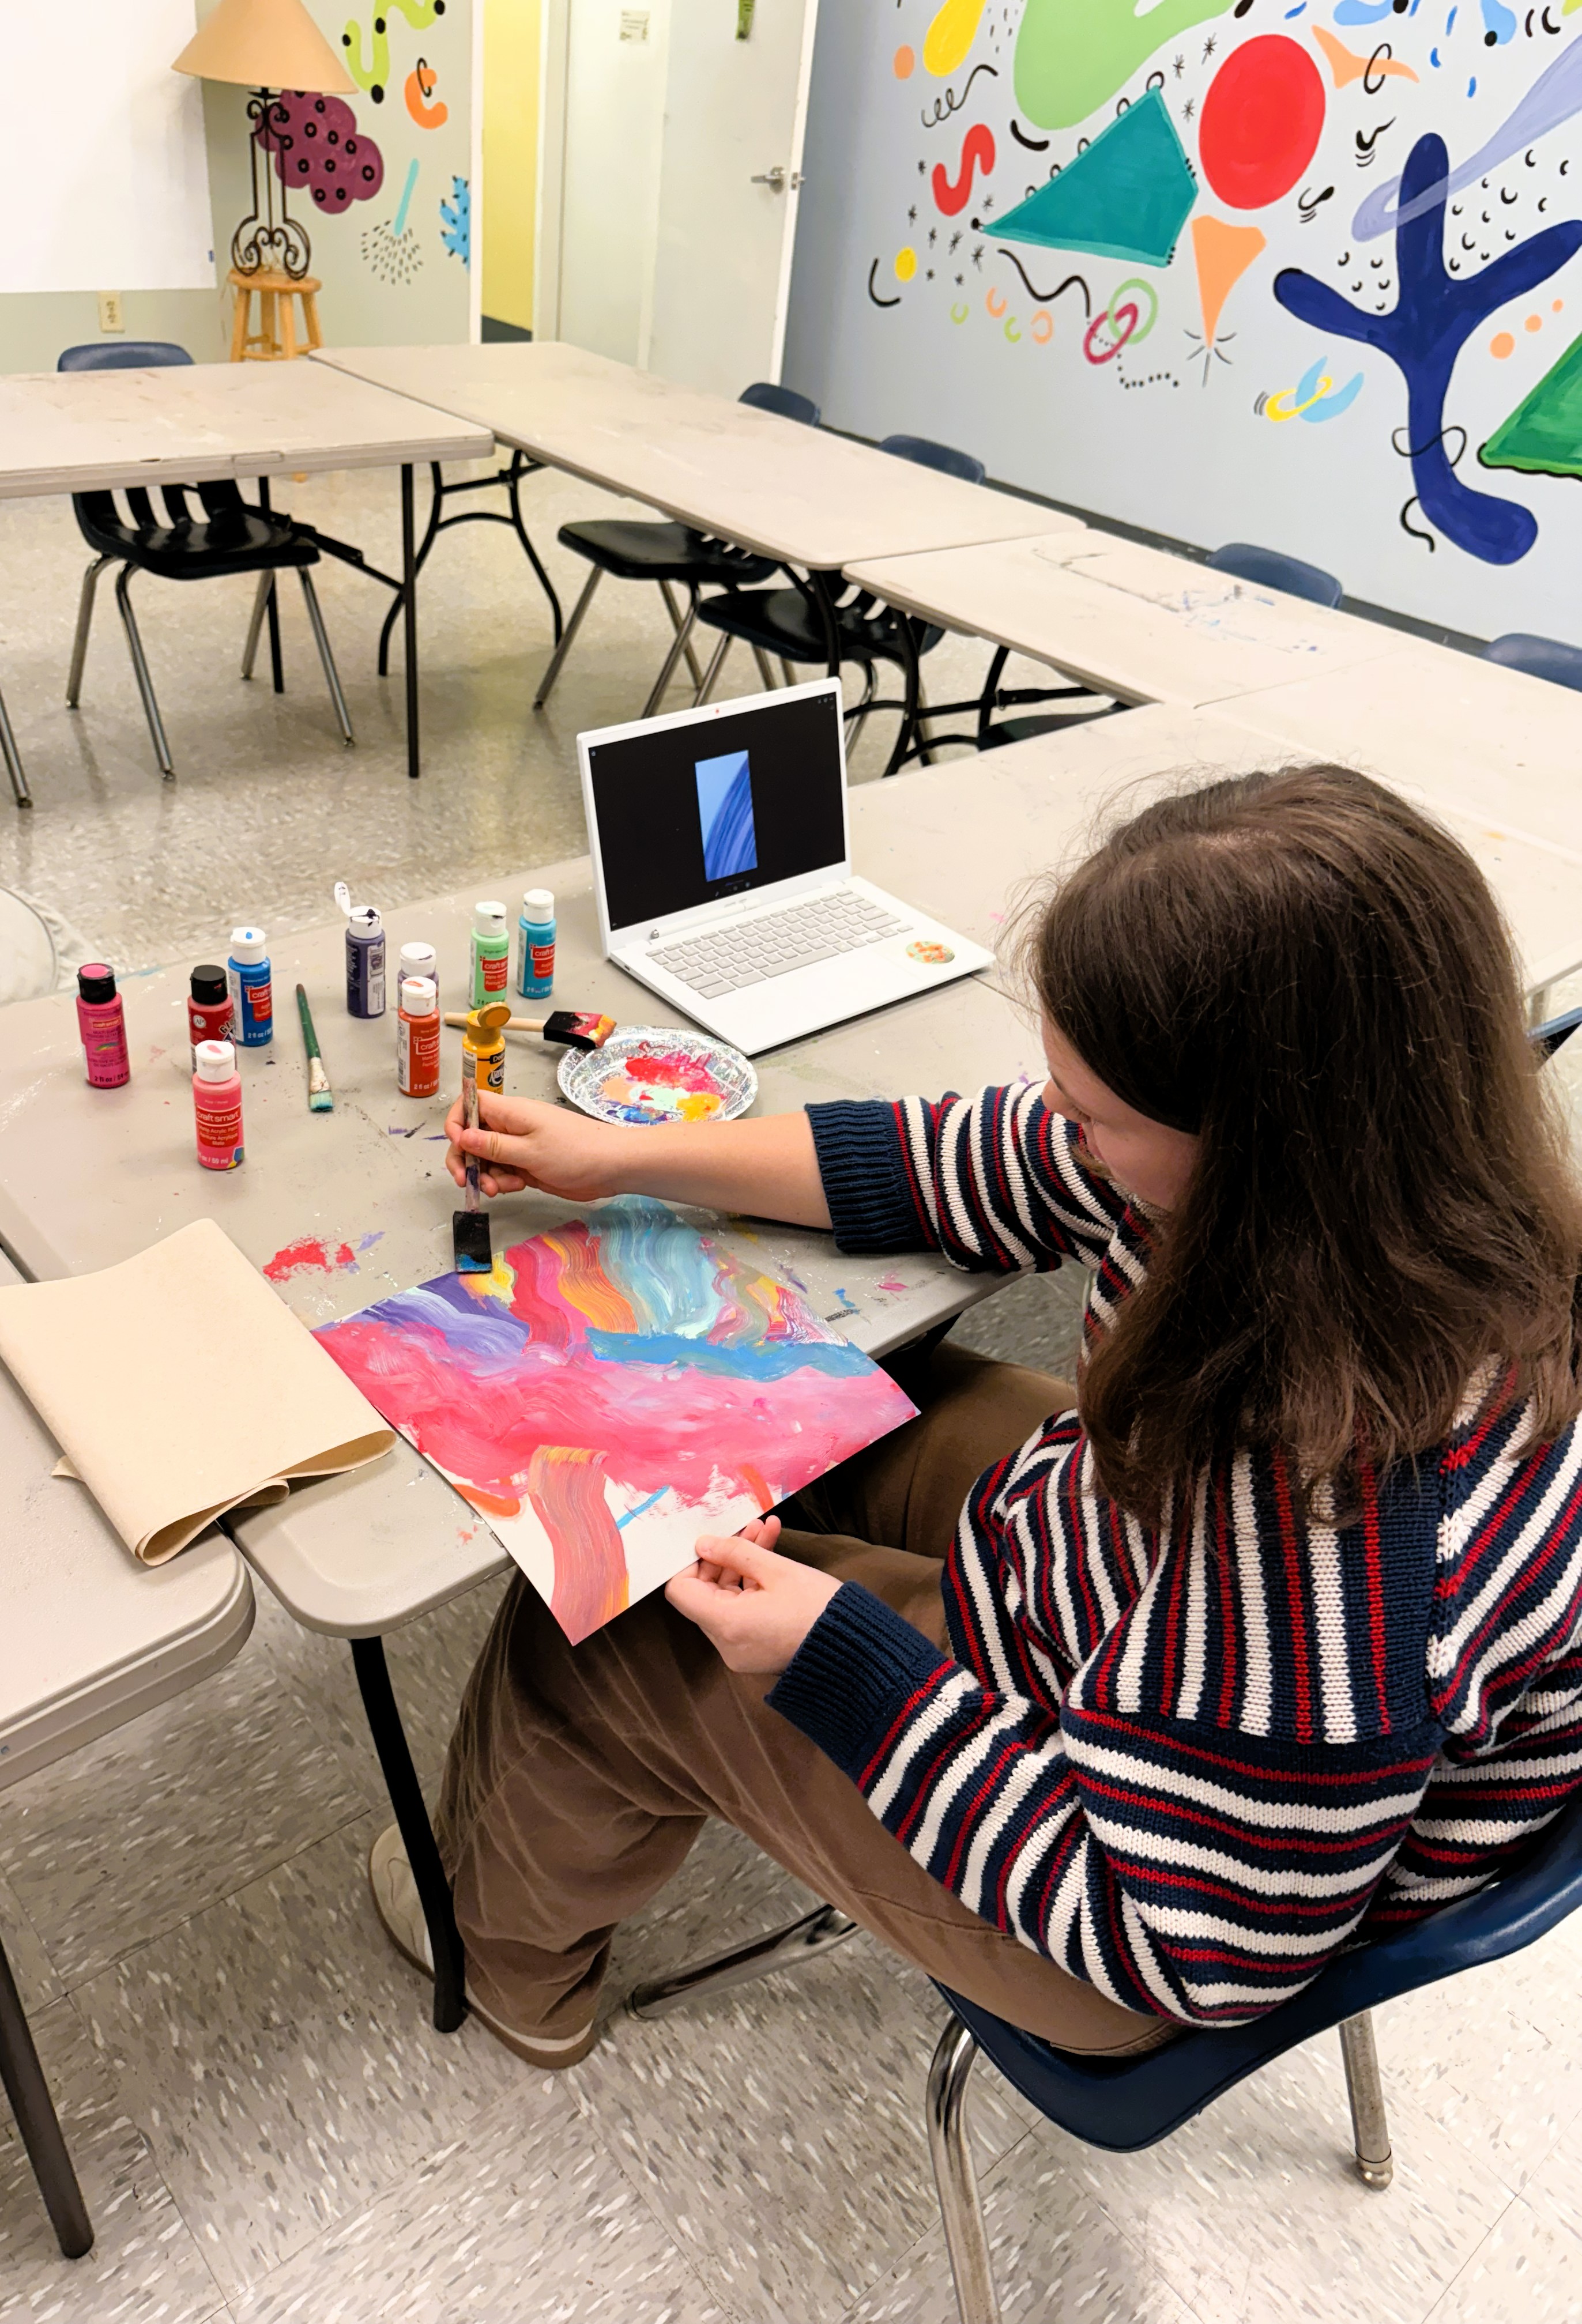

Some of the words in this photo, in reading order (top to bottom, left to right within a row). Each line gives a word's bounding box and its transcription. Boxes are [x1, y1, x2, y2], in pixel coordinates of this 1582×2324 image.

[534, 949, 550, 957] craft
[484, 961, 500, 969] craft
[420, 1040, 436, 1050] craft
[197, 1111, 214, 1122] craft
[214, 1111, 239, 1123] smart
